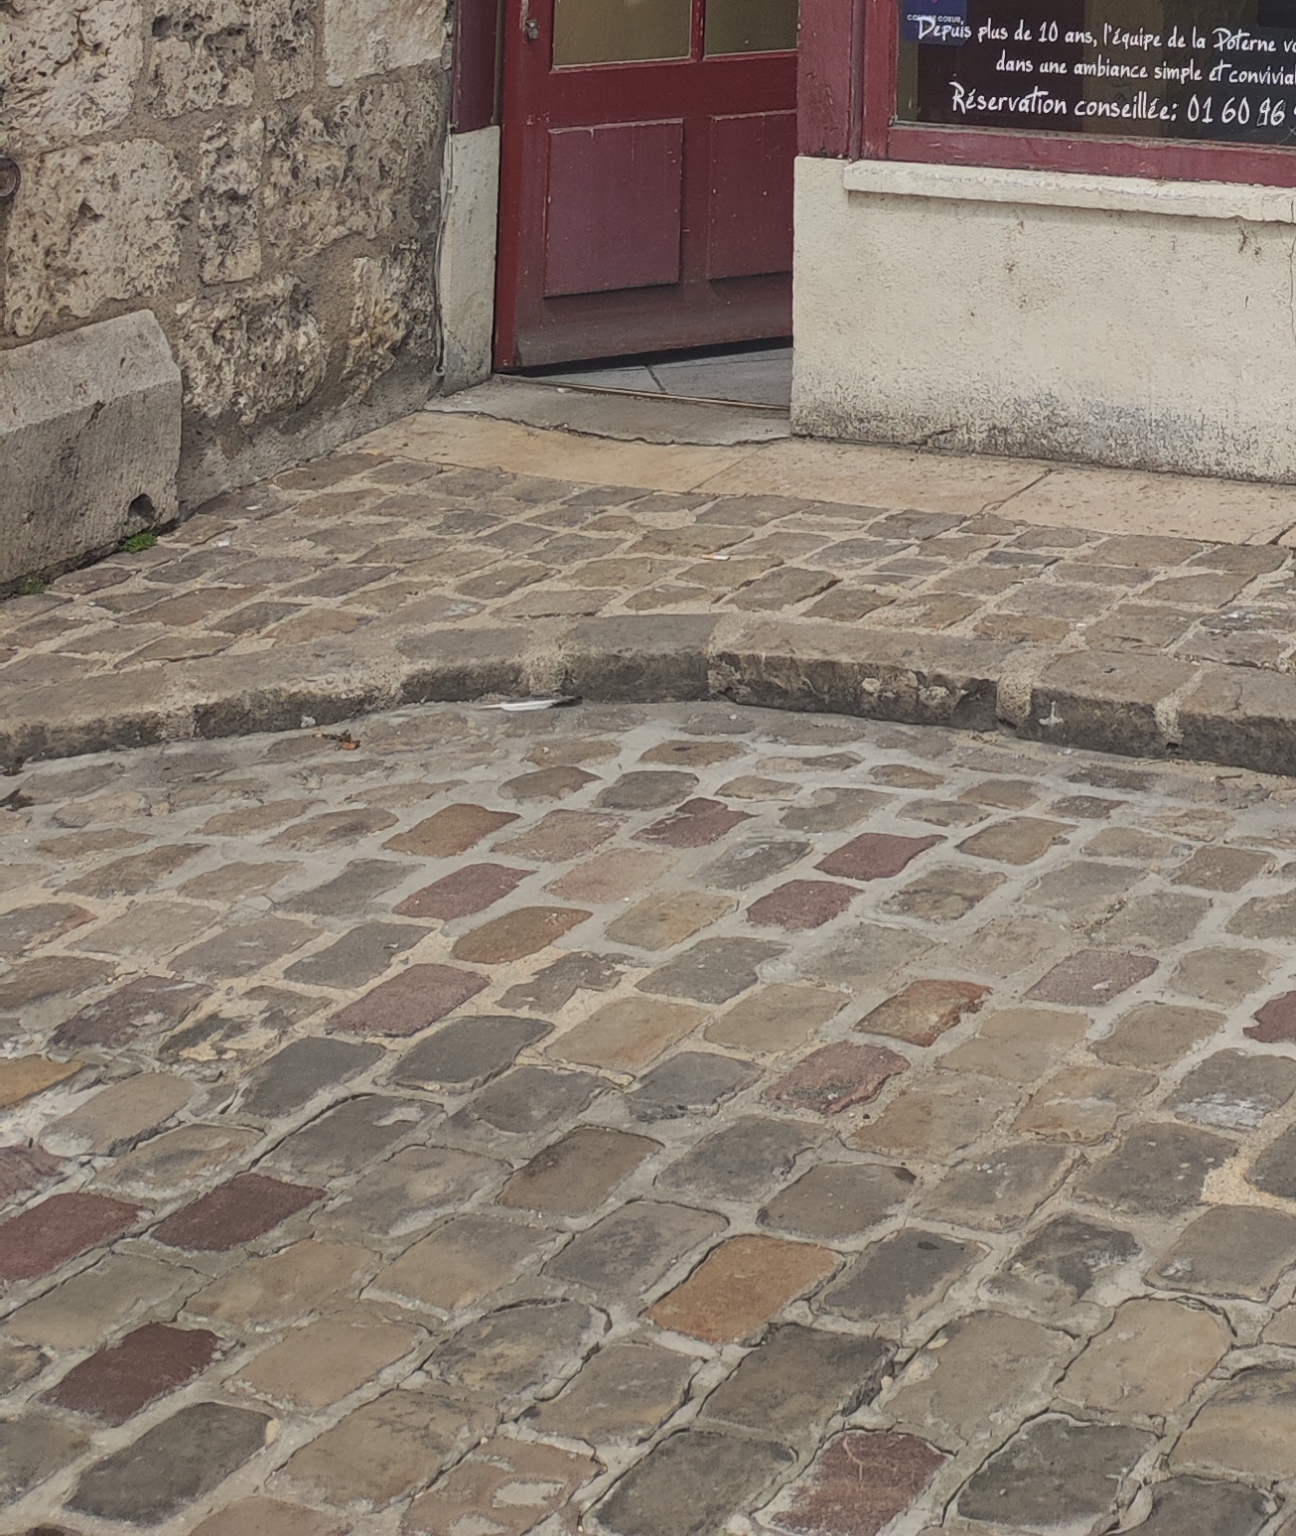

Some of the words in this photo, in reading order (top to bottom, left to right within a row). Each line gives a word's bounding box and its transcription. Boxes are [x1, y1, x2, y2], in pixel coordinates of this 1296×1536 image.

[917, 16, 972, 41] Depuis
[978, 18, 1008, 43] plus
[1014, 19, 1032, 41] de
[1038, 21, 1058, 42] 10
[1065, 31, 1098, 47] ans,
[1104, 23, 1162, 50] l'équipe
[1168, 26, 1186, 48] de
[1192, 26, 1206, 48] la
[1212, 28, 1277, 52] Poterne
[996, 49, 1033, 72] dans
[1040, 61, 1068, 74] une
[1074, 54, 1148, 78] ambiance
[1154, 59, 1202, 84] simple
[1209, 59, 1231, 82] et
[949, 82, 1067, 115] Réservation
[1074, 91, 1178, 121] conseillée:
[1187, 94, 1213, 123] 01
[1221, 97, 1249, 124] 60
[1259, 97, 1285, 126] 96
